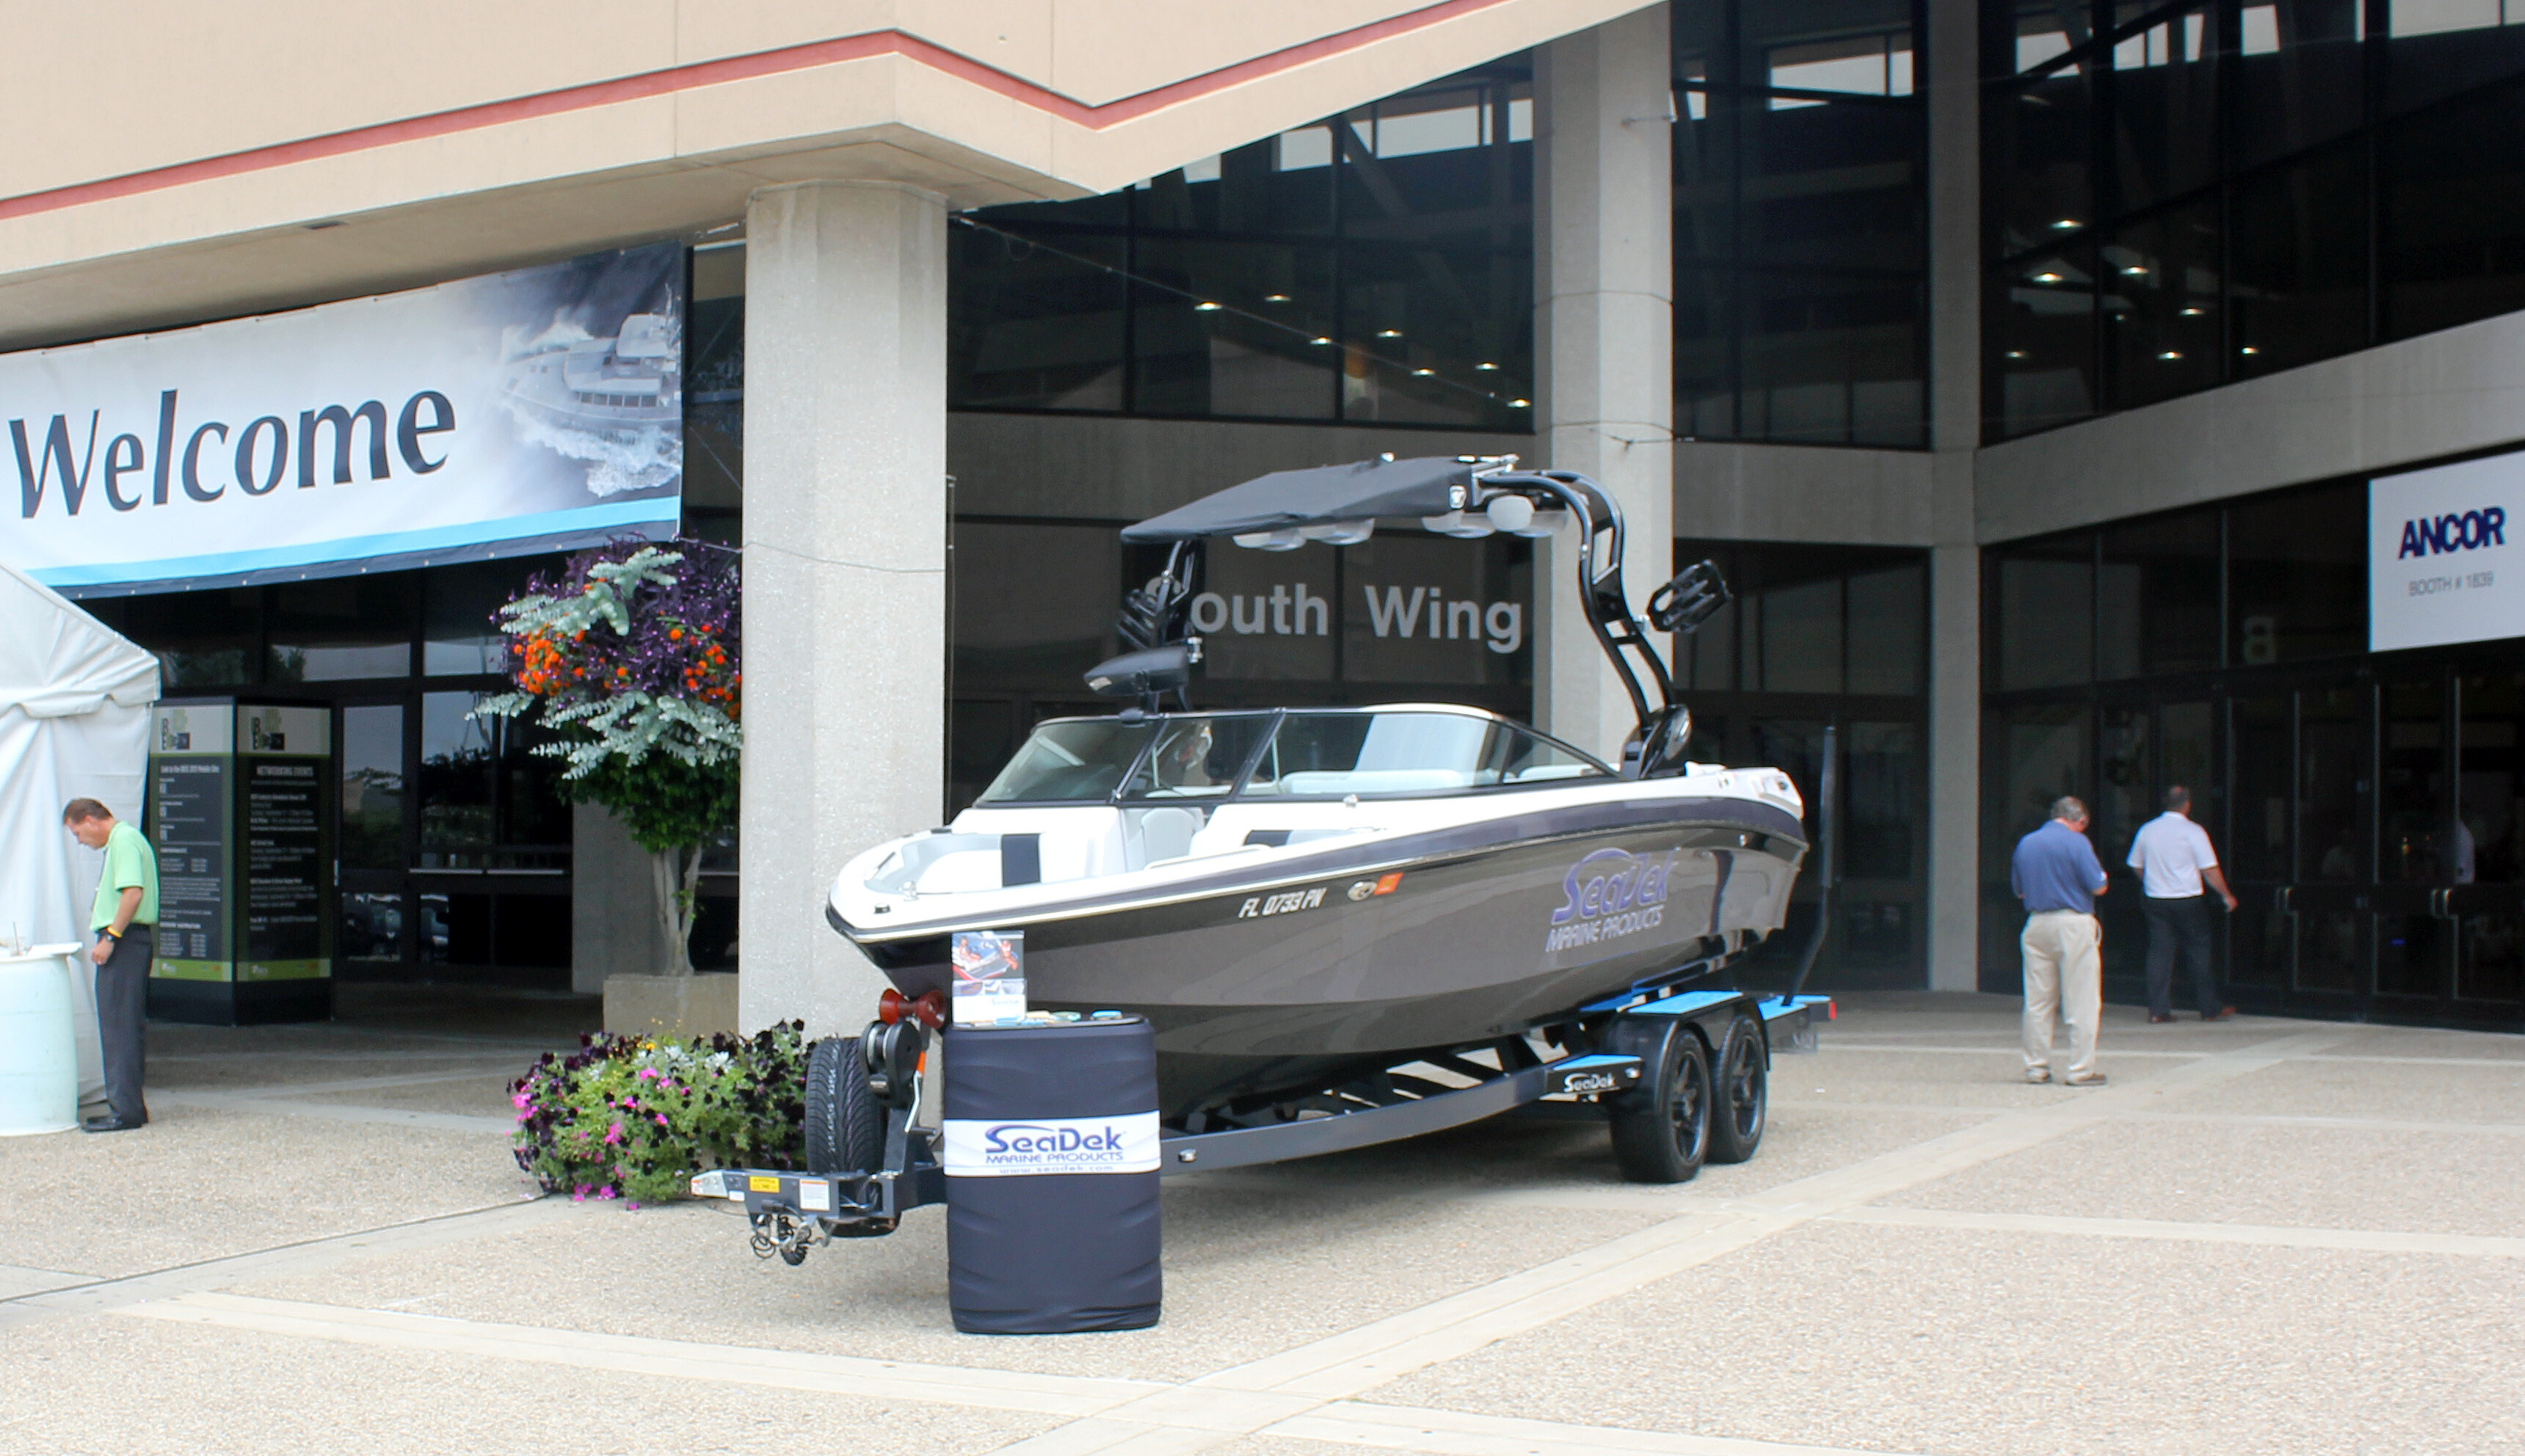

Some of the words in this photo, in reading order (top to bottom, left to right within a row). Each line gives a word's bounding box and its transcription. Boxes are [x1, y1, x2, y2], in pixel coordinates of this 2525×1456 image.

[8, 388, 457, 520] Welcome
[2397, 506, 2507, 560] ANCOR
[2408, 576, 2452, 597] BOOTH
[1364, 584, 1522, 654] Wing
[1550, 847, 1682, 925] SeaDek
[1238, 897, 1261, 919] FL
[1262, 890, 1307, 917] 0733
[1544, 919, 1603, 953] MARINE
[1599, 904, 1665, 942] PRODUCTS
[1563, 1072, 1616, 1093] SeaDek
[985, 1124, 1123, 1154] SeaDek
[986, 1154, 1042, 1165] MARINE
[1047, 1151, 1124, 1163] PRODUCTS
[999, 1164, 1113, 1174] www.seadek.com
